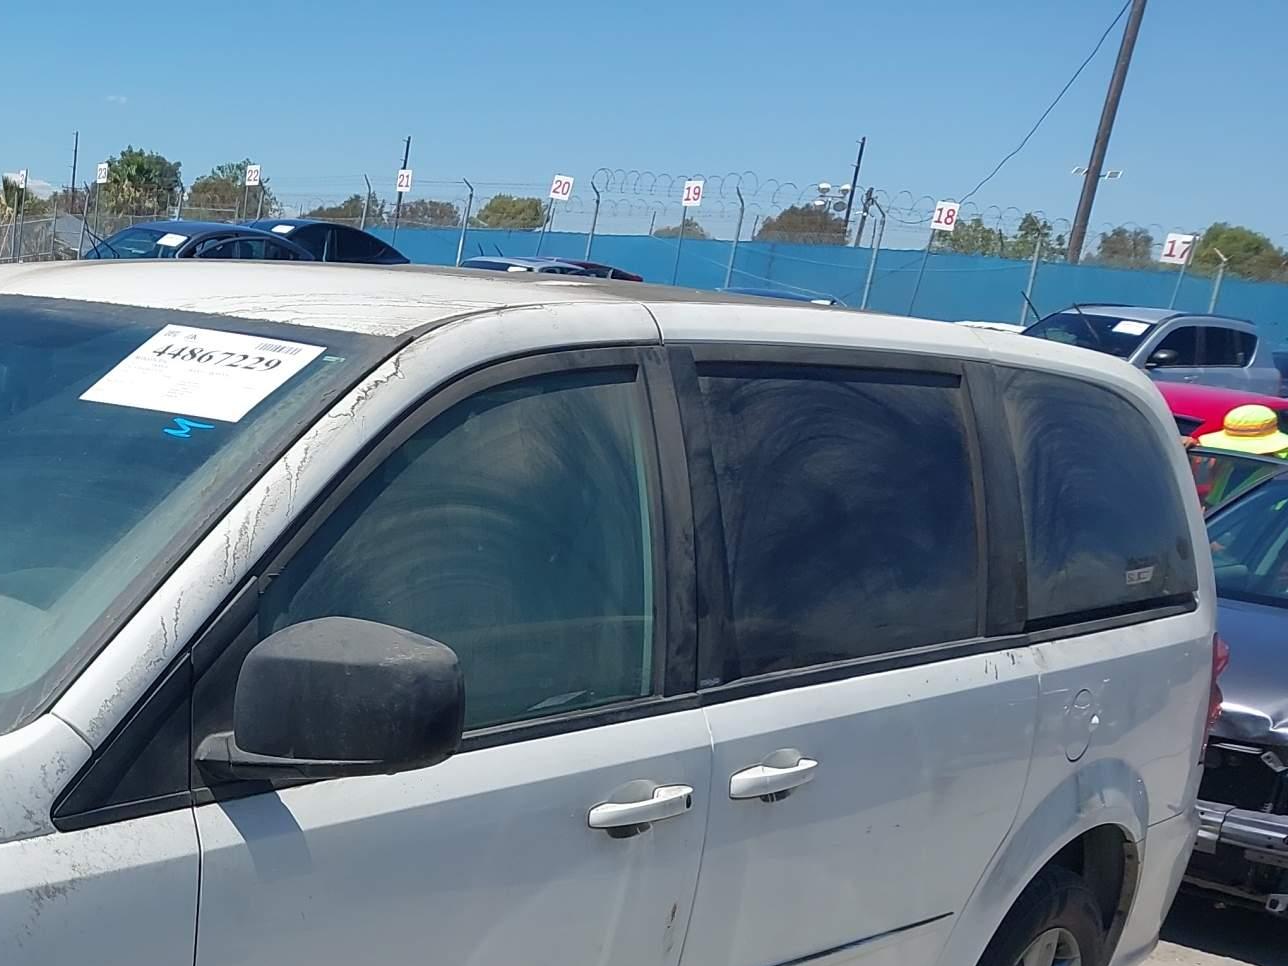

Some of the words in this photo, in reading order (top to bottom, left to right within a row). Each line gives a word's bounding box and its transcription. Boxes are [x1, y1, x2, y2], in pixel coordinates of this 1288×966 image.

[97, 167, 107, 179] 23
[247, 170, 259, 182] 22
[398, 175, 410, 188] 21
[552, 180, 571, 196] 20
[684, 186, 701, 202] 19
[934, 207, 956, 226] 18
[1164, 239, 1193, 260] 17
[152, 344, 282, 371] 44867229
